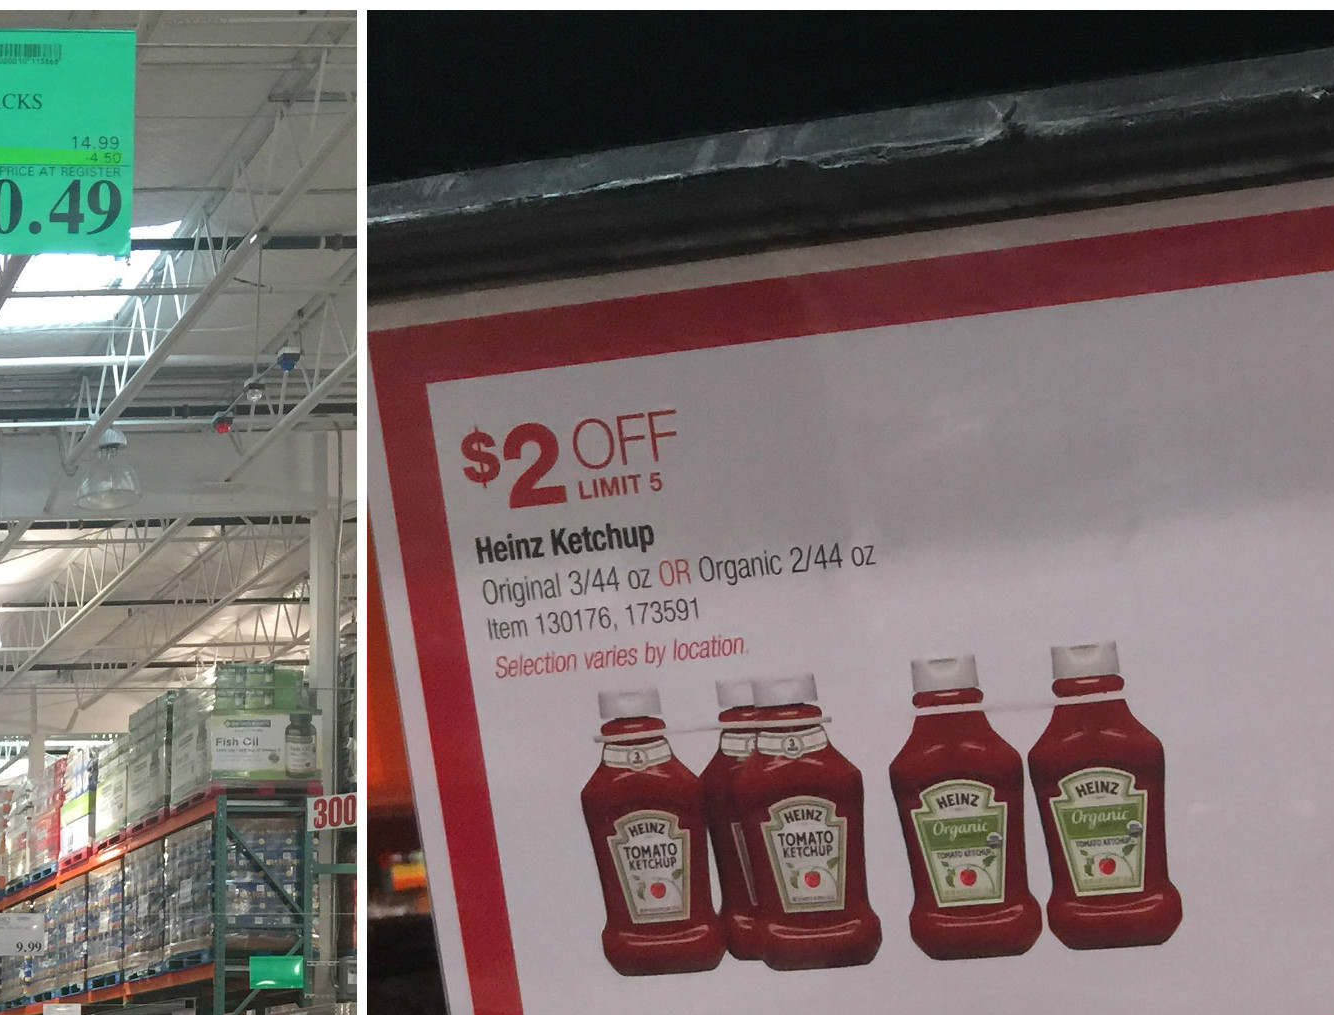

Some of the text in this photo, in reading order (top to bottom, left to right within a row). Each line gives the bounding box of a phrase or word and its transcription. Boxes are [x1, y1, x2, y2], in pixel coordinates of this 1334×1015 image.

[72, 136, 119, 150] 14.99
[0, 167, 120, 177] PRICE AT REGISTER
[460, 409, 678, 511] $2 OFF
[577, 472, 664, 501] LIMIT 5
[475, 522, 656, 565] Heinz Ketchup
[481, 542, 877, 609] Original 3/44 oz OR Organic 2/44 oz
[486, 598, 701, 641] Item 130176, 173591
[494, 653, 578, 680] Selection
[583, 644, 639, 670] varies
[644, 641, 666, 668] by
[215, 737, 259, 746] Fish Oil
[313, 795, 357, 828] 300
[16, 942, 42, 952] 9.99
